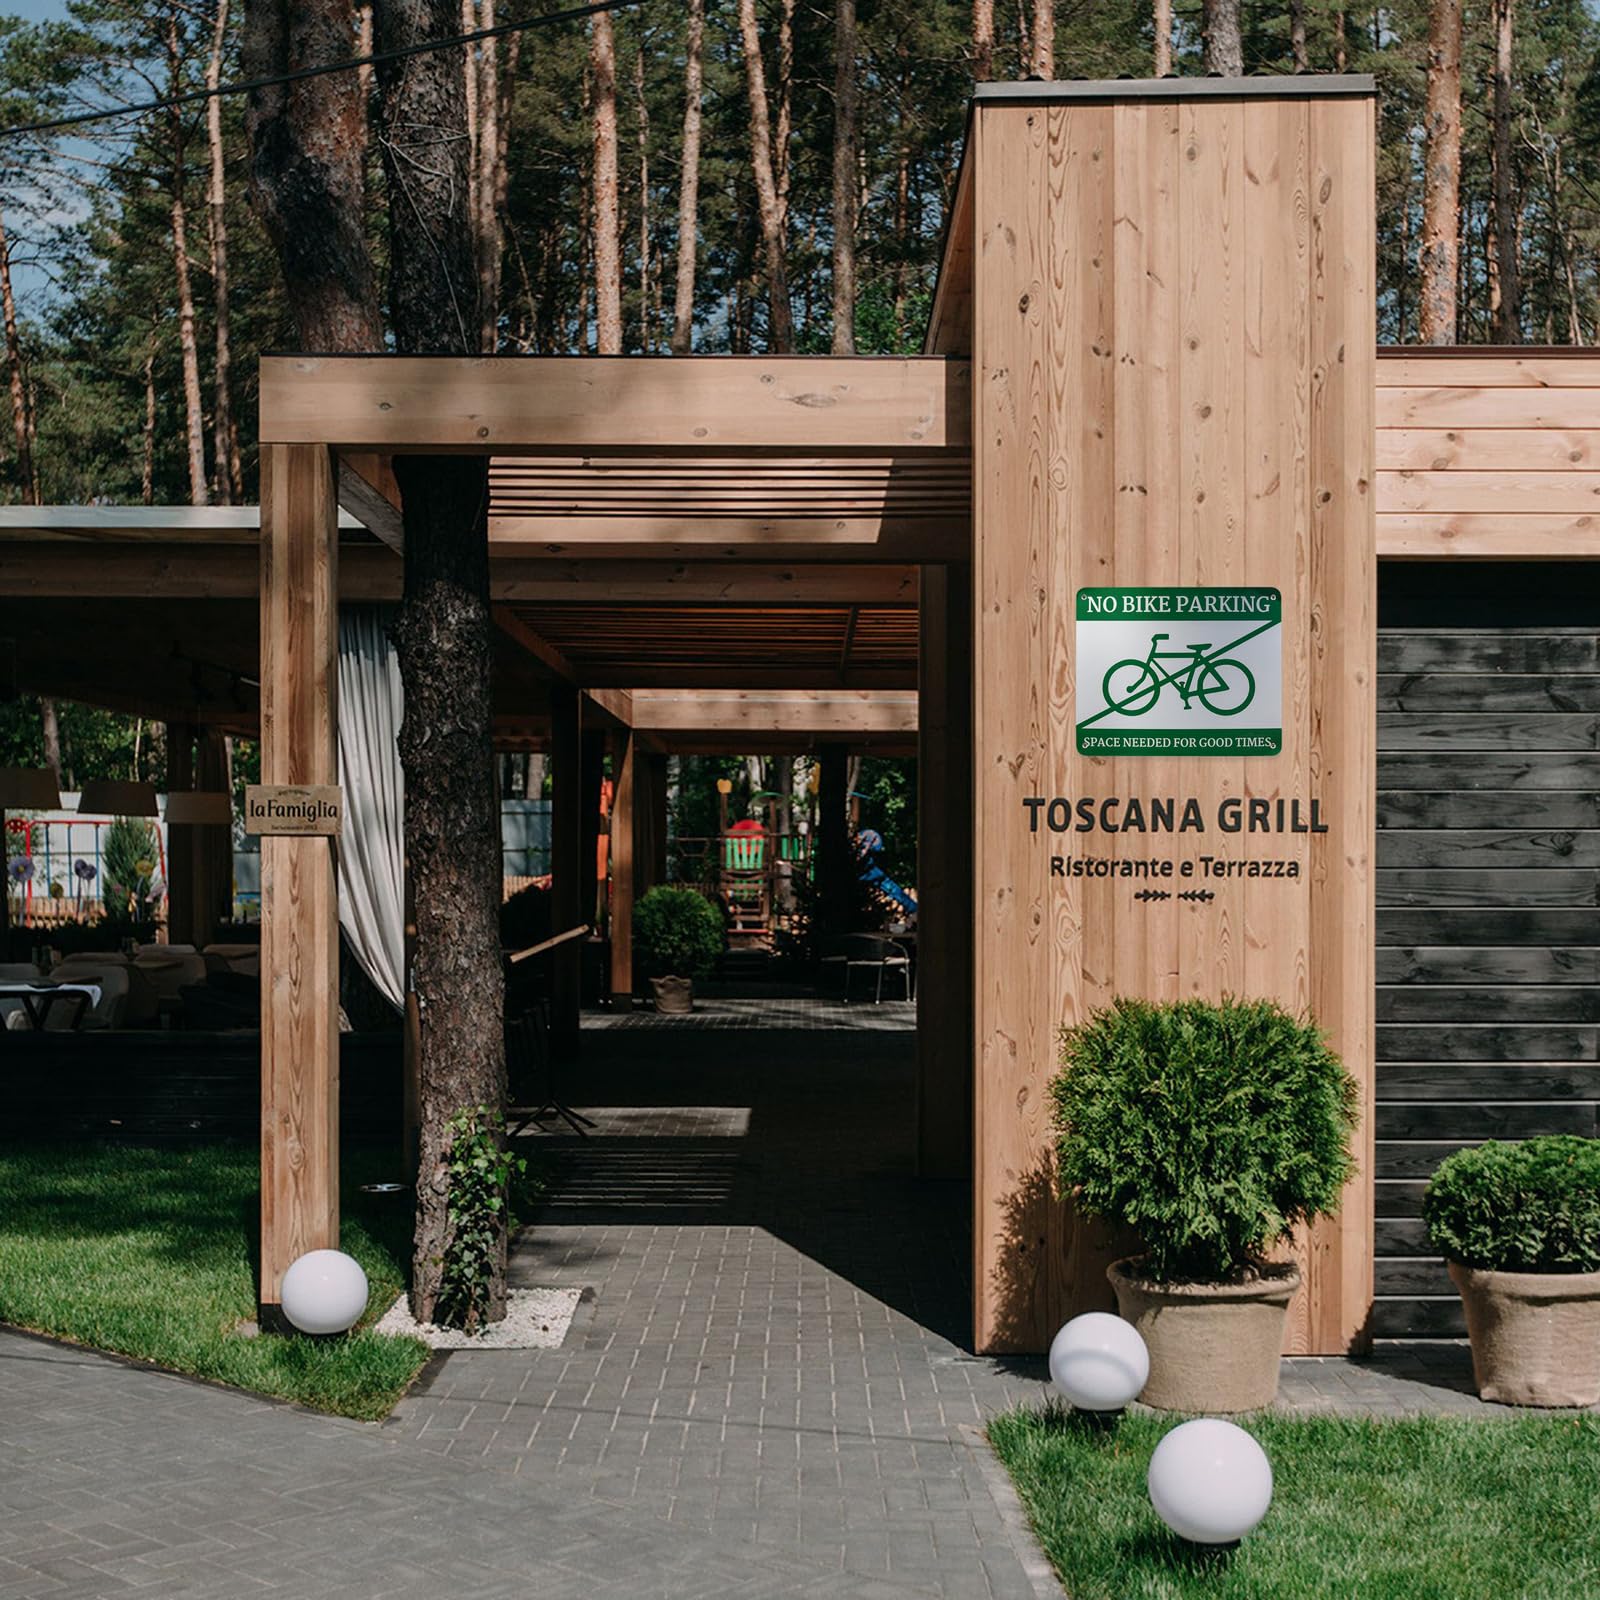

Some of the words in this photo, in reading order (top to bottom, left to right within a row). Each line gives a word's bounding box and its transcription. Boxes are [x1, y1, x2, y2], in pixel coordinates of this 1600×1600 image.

[1087, 596, 1117, 613] NO
[1122, 596, 1171, 613] BIKE
[1175, 596, 1271, 613] PARKING
[1083, 736, 1121, 748] SPACE
[1123, 736, 1171, 748] NEEDED
[1173, 736, 1197, 748] FOR
[1199, 736, 1233, 748] GOOD
[1022, 798, 1205, 833] TOSCANA
[1217, 798, 1329, 833] GRILL
[1050, 855, 1173, 878] Ristorante
[1180, 861, 1194, 878] e
[1200, 856, 1299, 878] Terrazza
